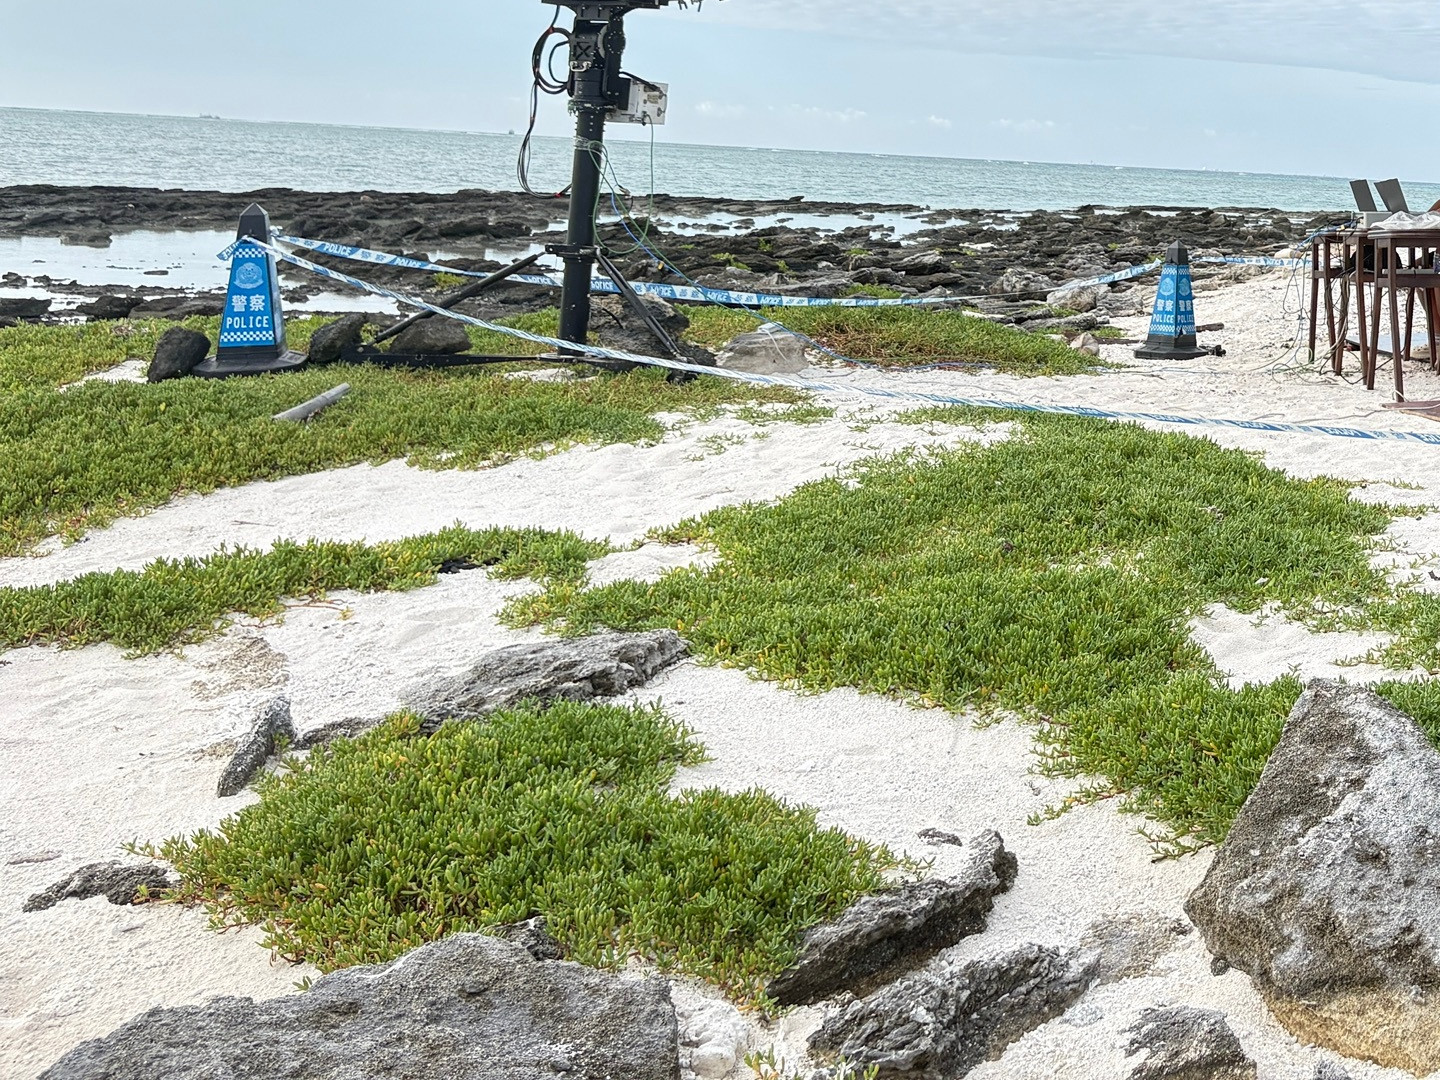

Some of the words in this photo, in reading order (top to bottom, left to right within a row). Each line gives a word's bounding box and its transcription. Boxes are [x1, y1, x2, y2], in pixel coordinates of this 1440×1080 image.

[324, 243, 351, 255] POLICE
[231, 294, 265, 312] 警察
[226, 316, 269, 329] POLICE
[1153, 314, 1174, 323] POLICE
